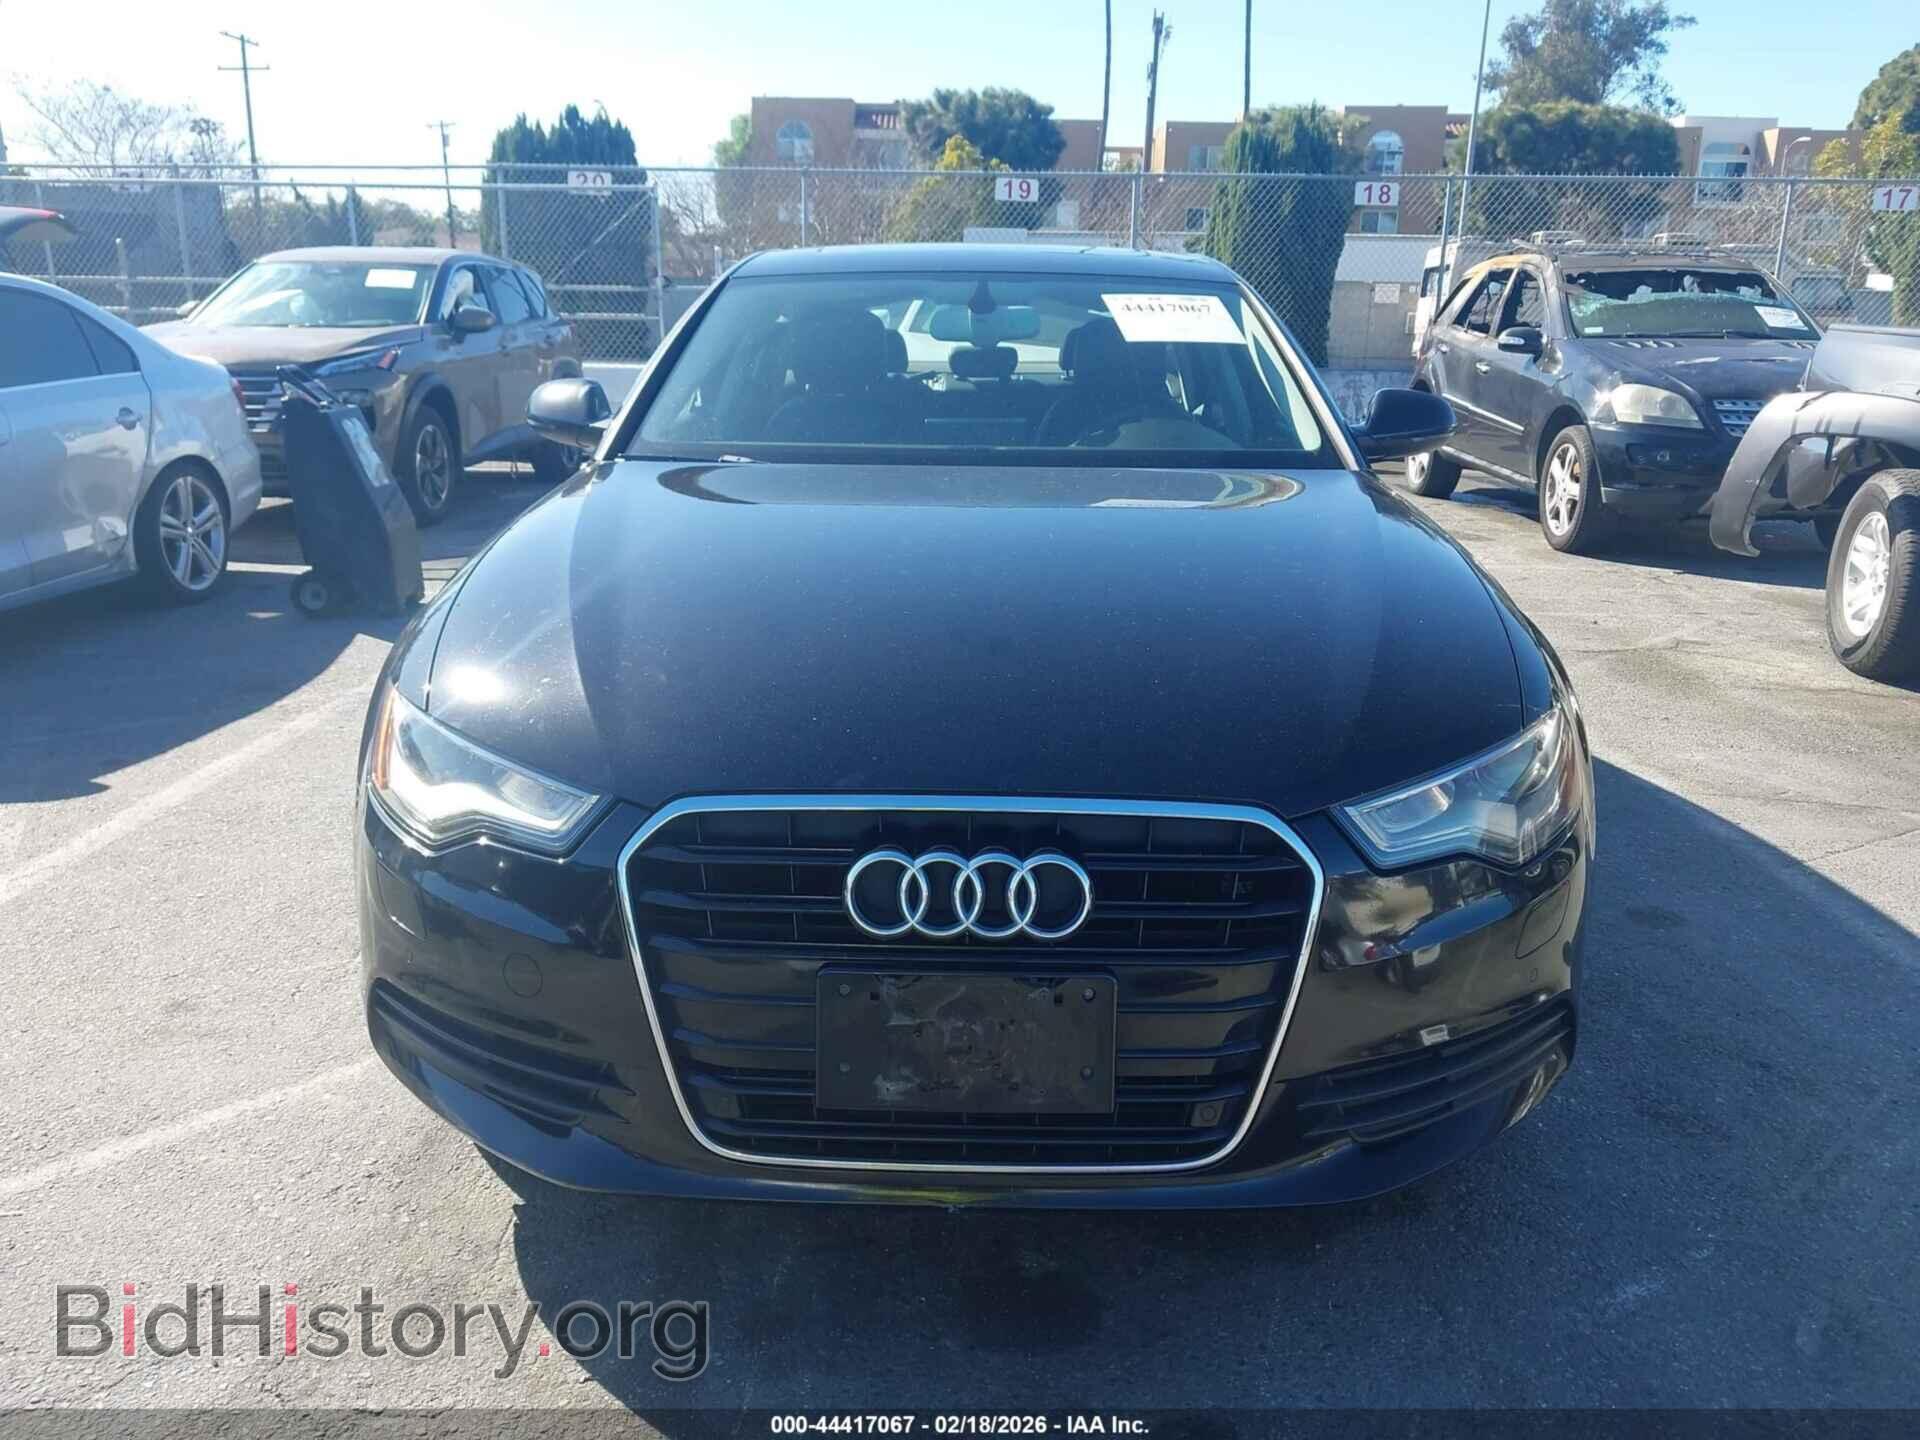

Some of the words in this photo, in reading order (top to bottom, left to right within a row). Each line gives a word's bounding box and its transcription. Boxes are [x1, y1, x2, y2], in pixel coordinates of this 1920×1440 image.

[575, 172, 605, 187] 20
[1003, 179, 1031, 200] 19
[1363, 183, 1391, 204] 18
[1882, 188, 1913, 209] 17
